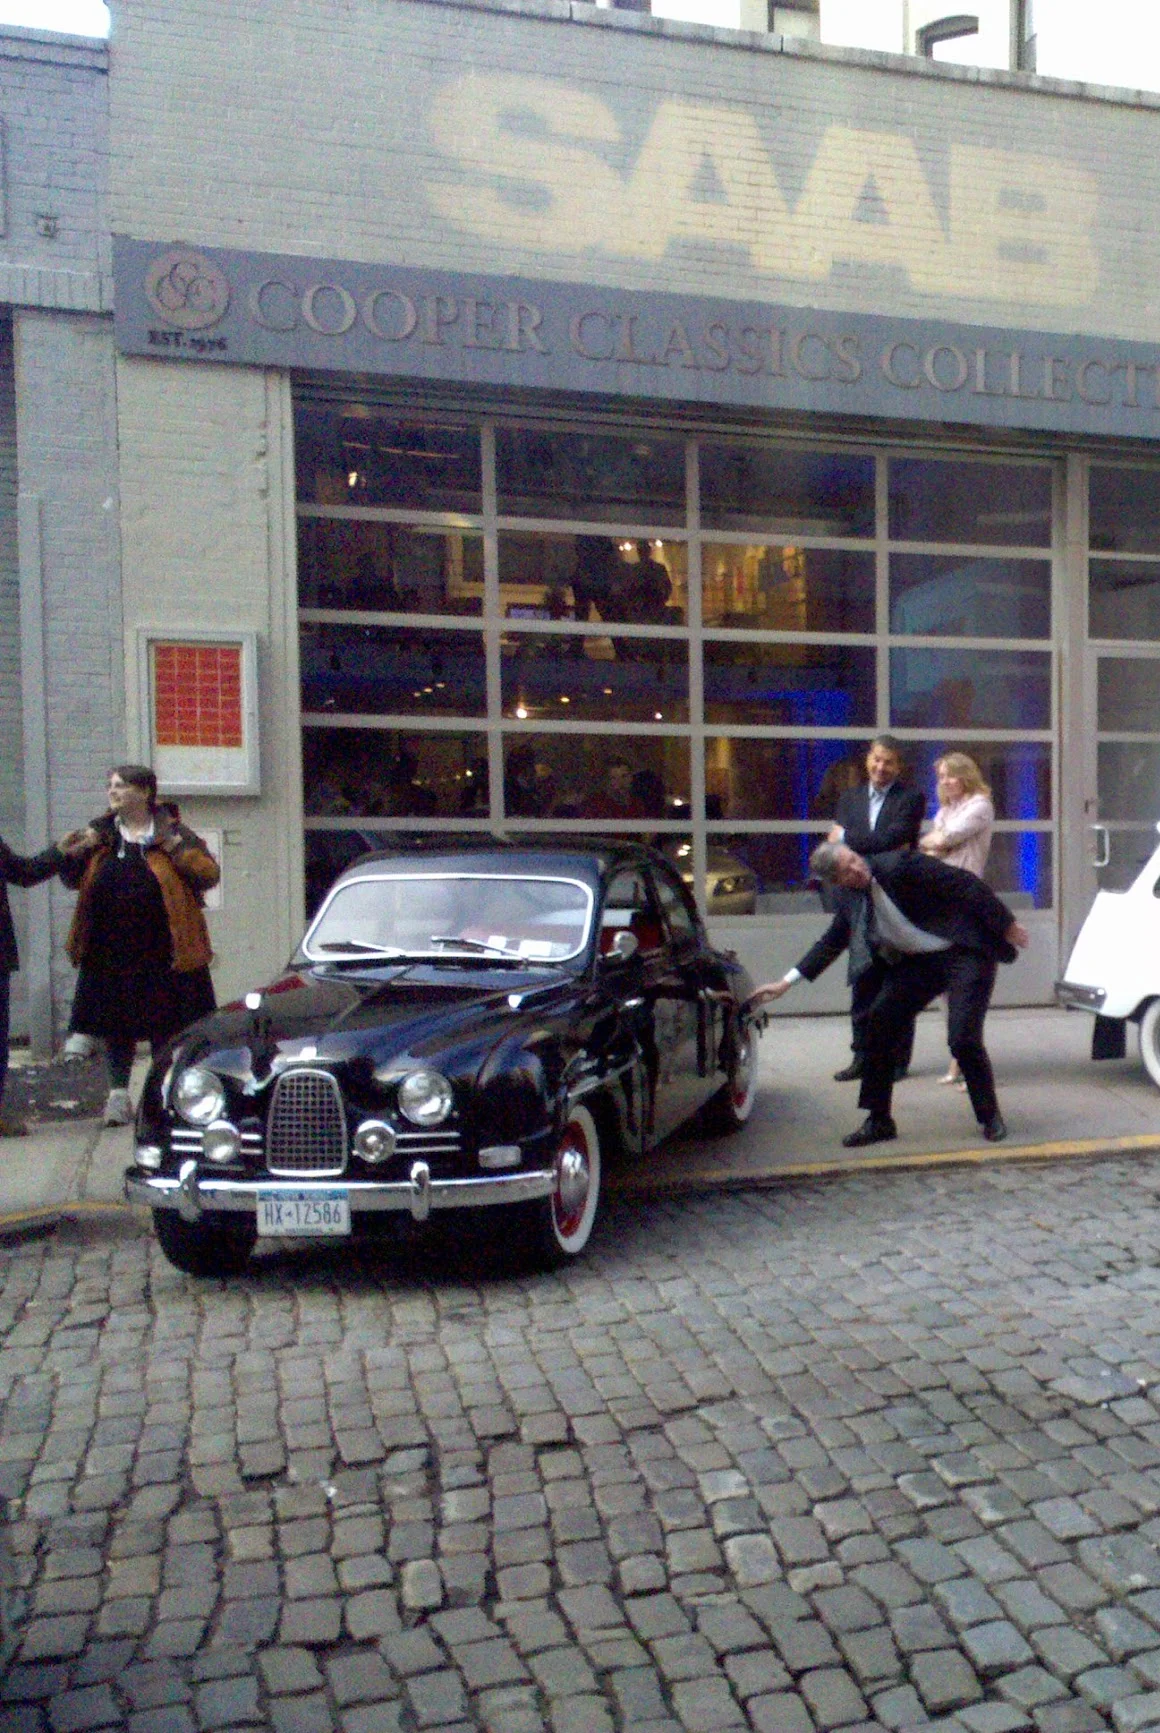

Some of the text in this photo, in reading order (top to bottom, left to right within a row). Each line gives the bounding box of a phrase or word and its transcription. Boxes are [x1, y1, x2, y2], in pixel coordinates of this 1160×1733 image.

[424, 70, 1098, 303] SAAB
[251, 280, 552, 355] COOPER
[568, 311, 864, 385] CLASSICS
